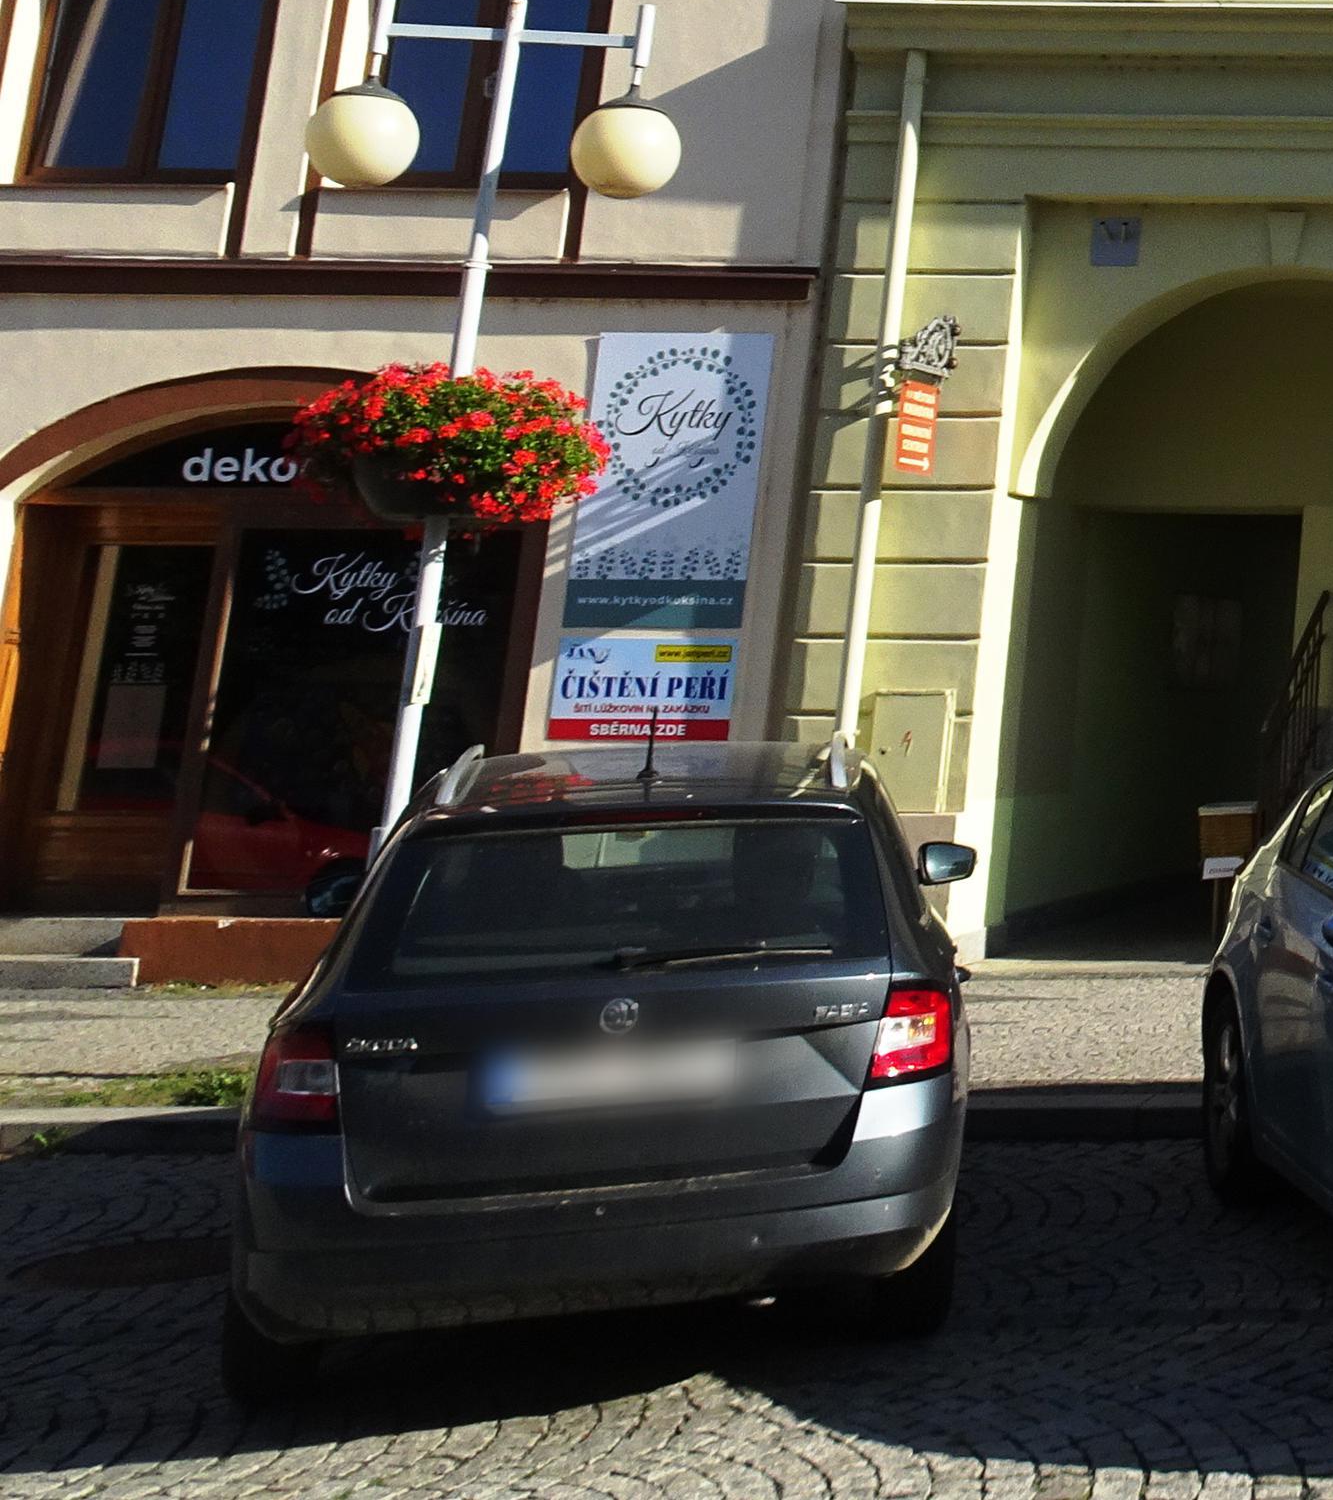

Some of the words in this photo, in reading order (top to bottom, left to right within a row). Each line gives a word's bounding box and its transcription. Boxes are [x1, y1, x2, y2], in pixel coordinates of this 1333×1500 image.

[615, 389, 733, 468] Kytky
[182, 447, 299, 483] deko
[292, 552, 398, 600] Kytky
[324, 597, 363, 625] od
[362, 591, 488, 632] Kšína
[577, 595, 733, 607] www.kytkyodkuksina.cz
[561, 668, 660, 700] ČIŠTĚNÍ
[667, 669, 729, 700] PEŘÍ
[590, 722, 651, 736] SBĚRNA
[655, 724, 687, 736] ZDE
